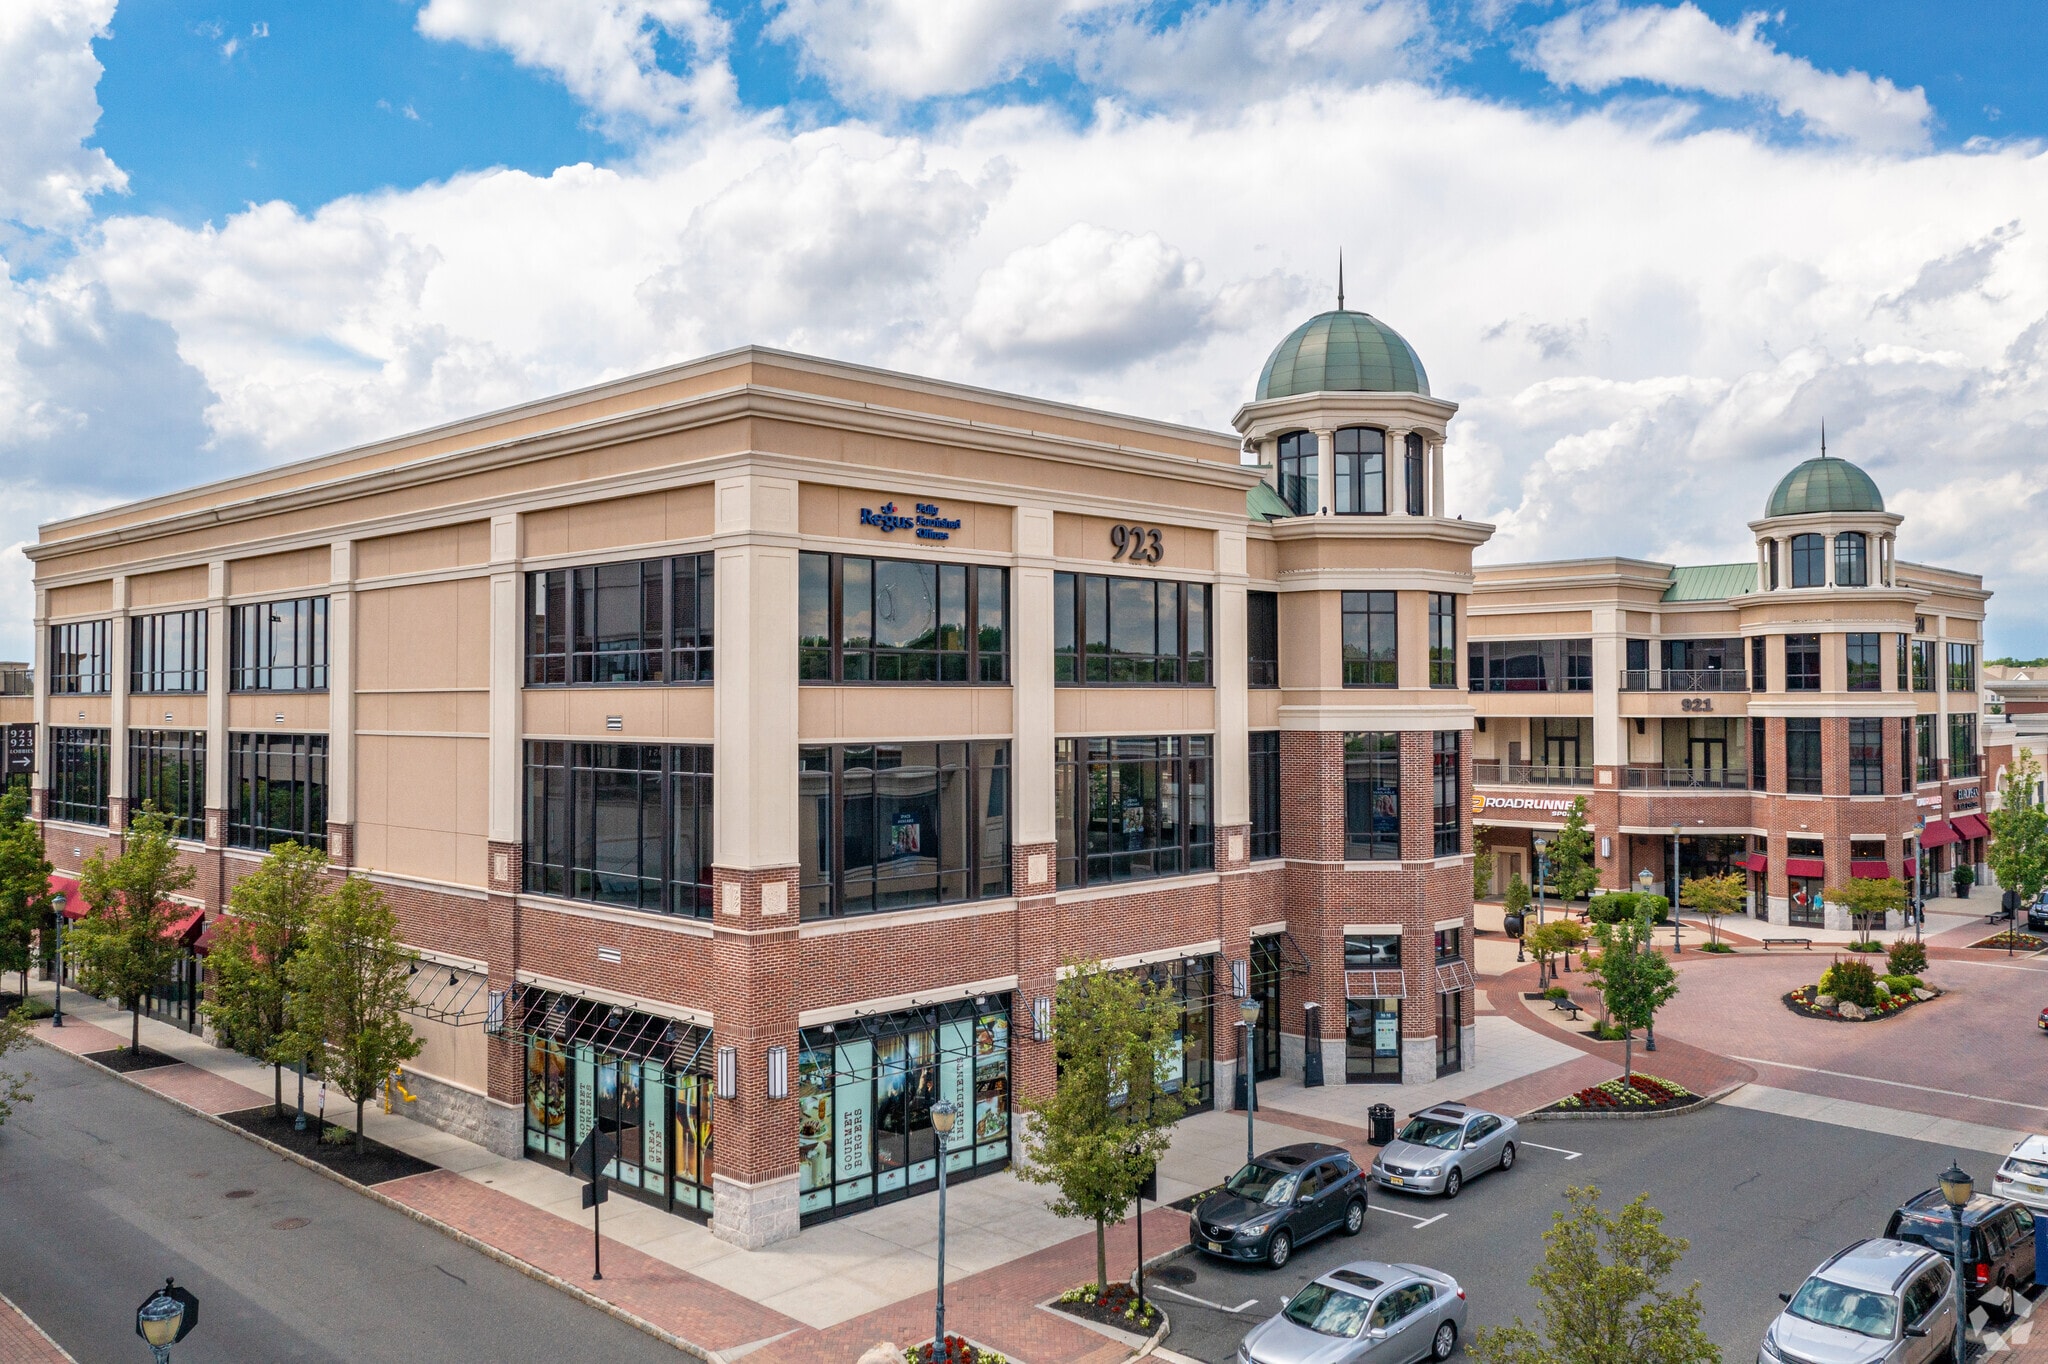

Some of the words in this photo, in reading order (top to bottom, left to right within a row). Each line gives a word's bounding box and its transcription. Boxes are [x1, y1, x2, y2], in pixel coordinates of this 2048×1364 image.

[916, 503, 939, 516] Fully
[860, 507, 915, 533] Regus
[916, 515, 961, 529] Furnished
[915, 528, 949, 540] Offices
[1110, 524, 1164, 563] 923
[1681, 698, 1714, 712] 921
[10, 729, 33, 738] 921
[10, 738, 33, 747] 923
[1485, 797, 1578, 811] ROADRUNNE
[956, 1056, 965, 1141] INGREDIENTS
[648, 1120, 656, 1162] GREAT
[656, 1131, 664, 1163] WINE
[844, 1111, 853, 1171] GOURMET
[854, 1108, 863, 1169] BURGERS
